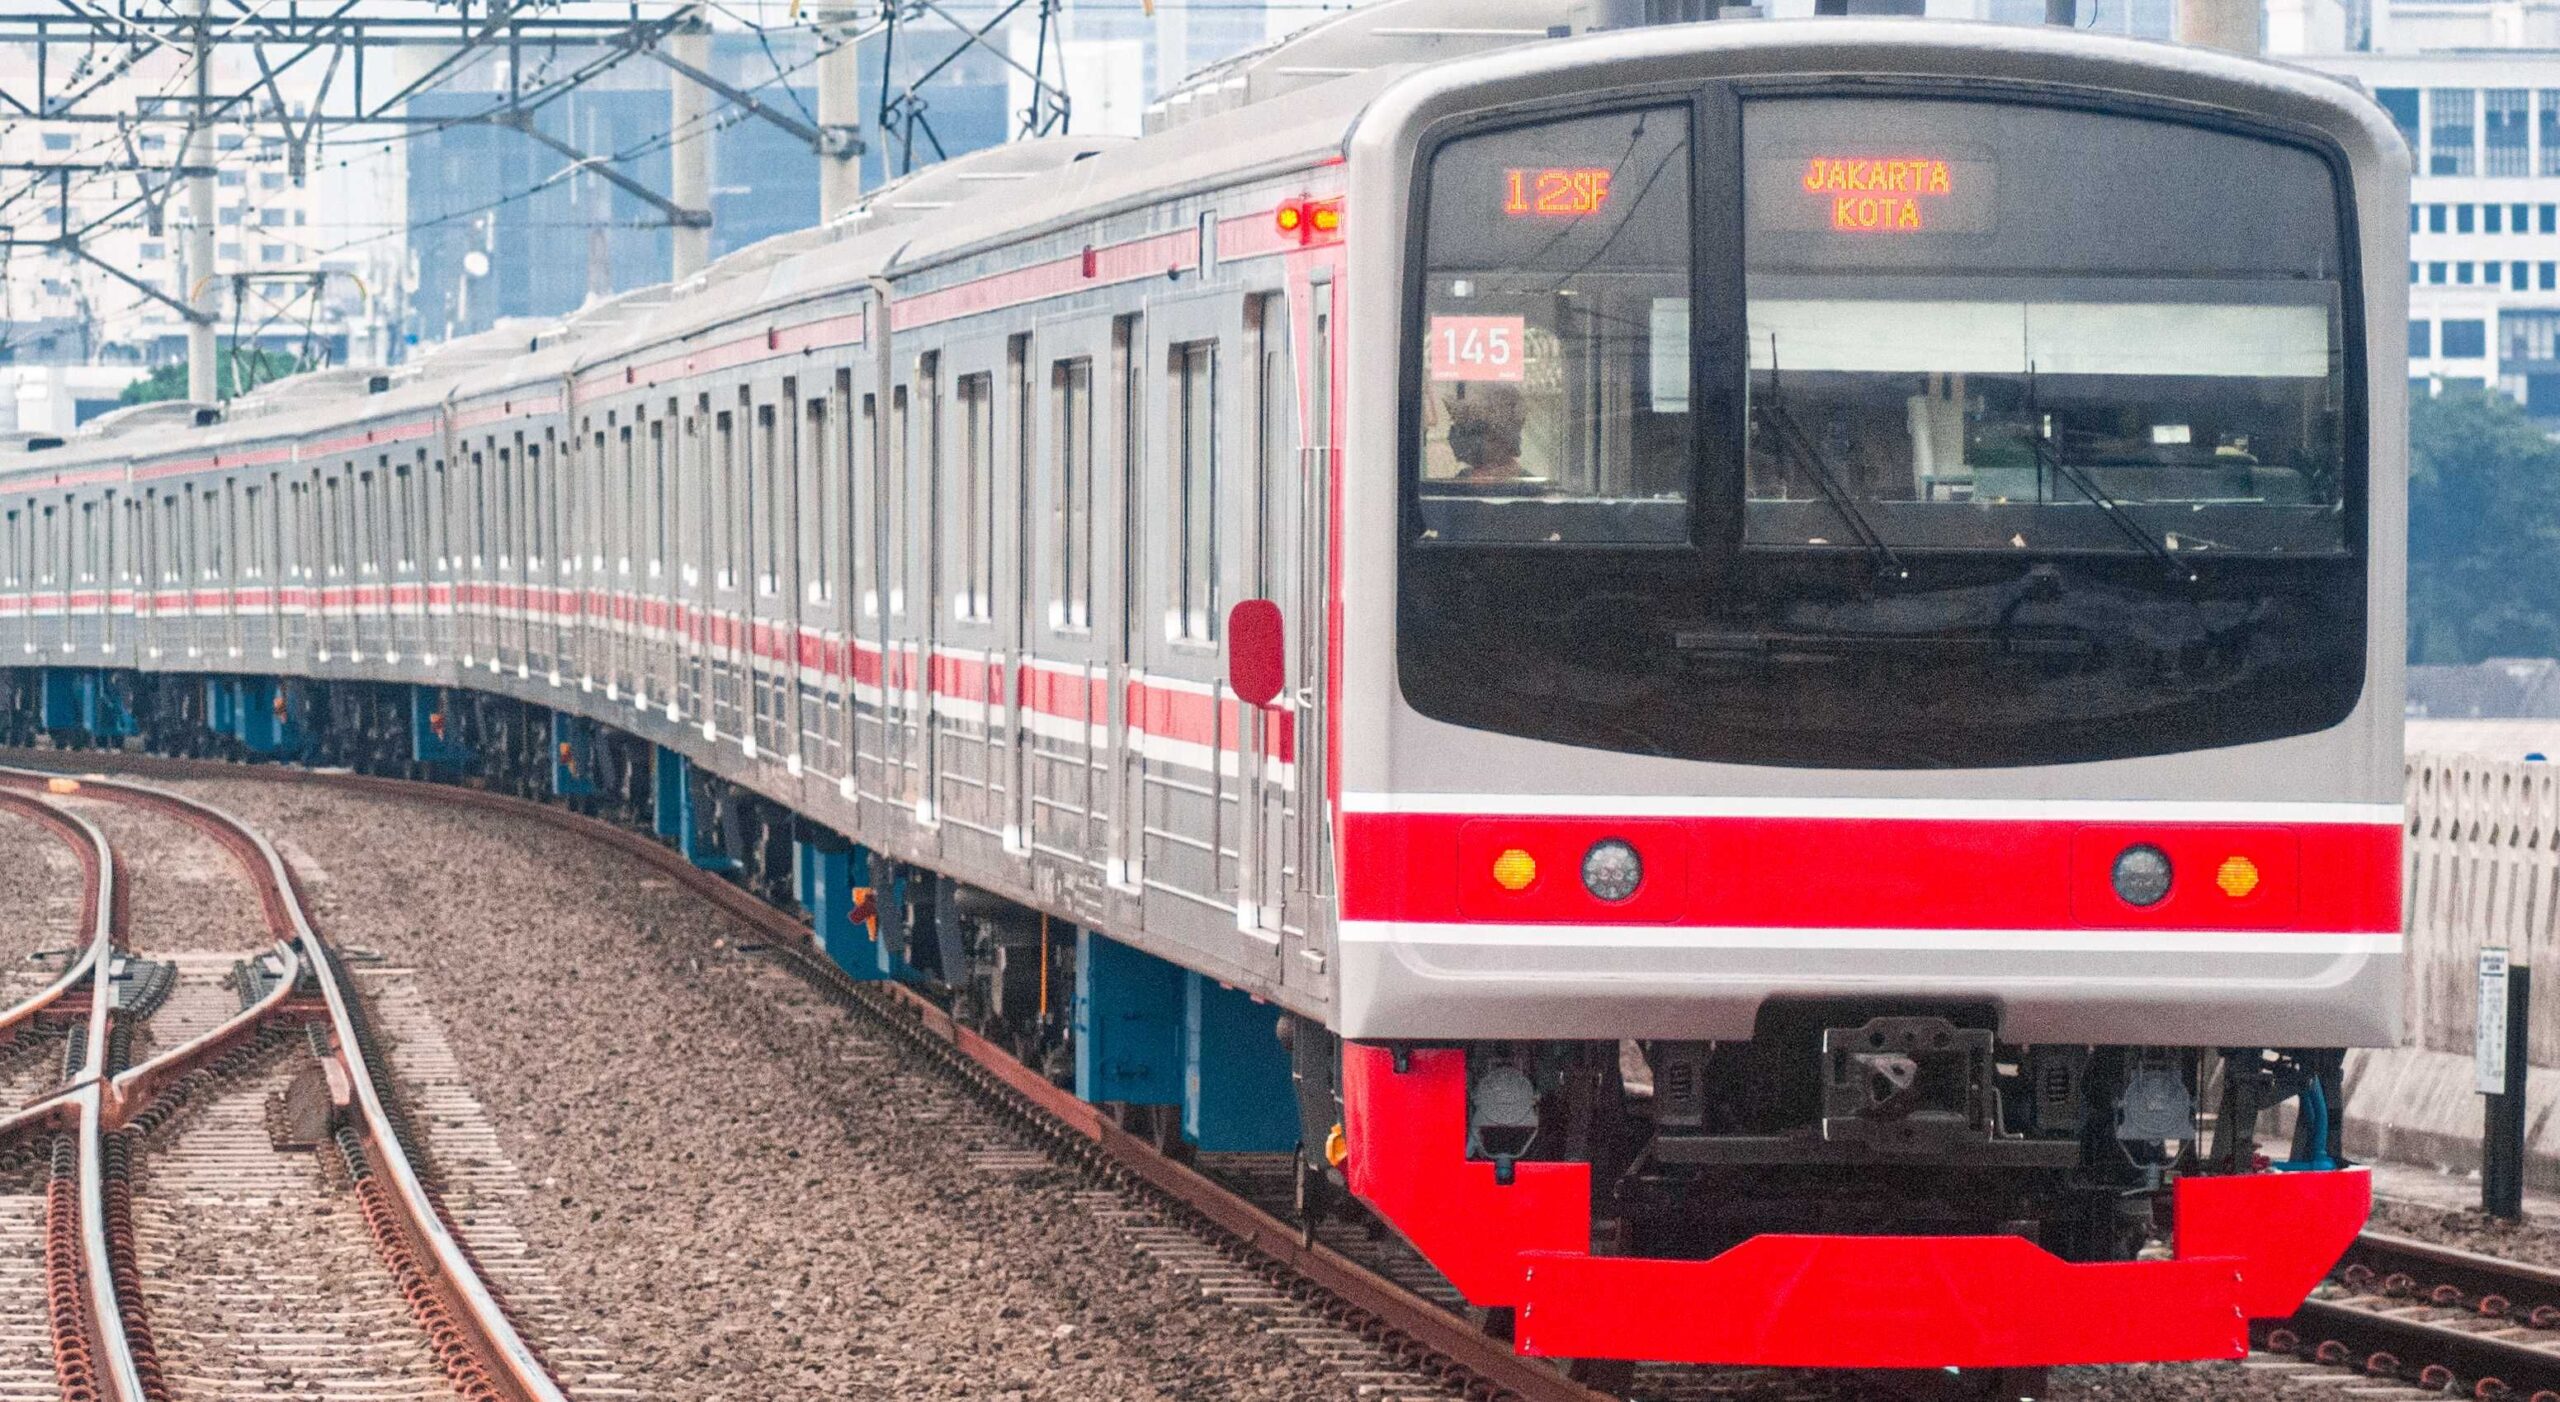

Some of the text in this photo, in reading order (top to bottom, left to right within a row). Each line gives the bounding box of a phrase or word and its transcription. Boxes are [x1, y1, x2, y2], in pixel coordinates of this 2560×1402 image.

[1505, 170, 1610, 212] 12SF
[1805, 158, 1950, 193] JAKARTA
[1835, 196, 1921, 229] KOTA
[1443, 327, 1510, 366] 145
